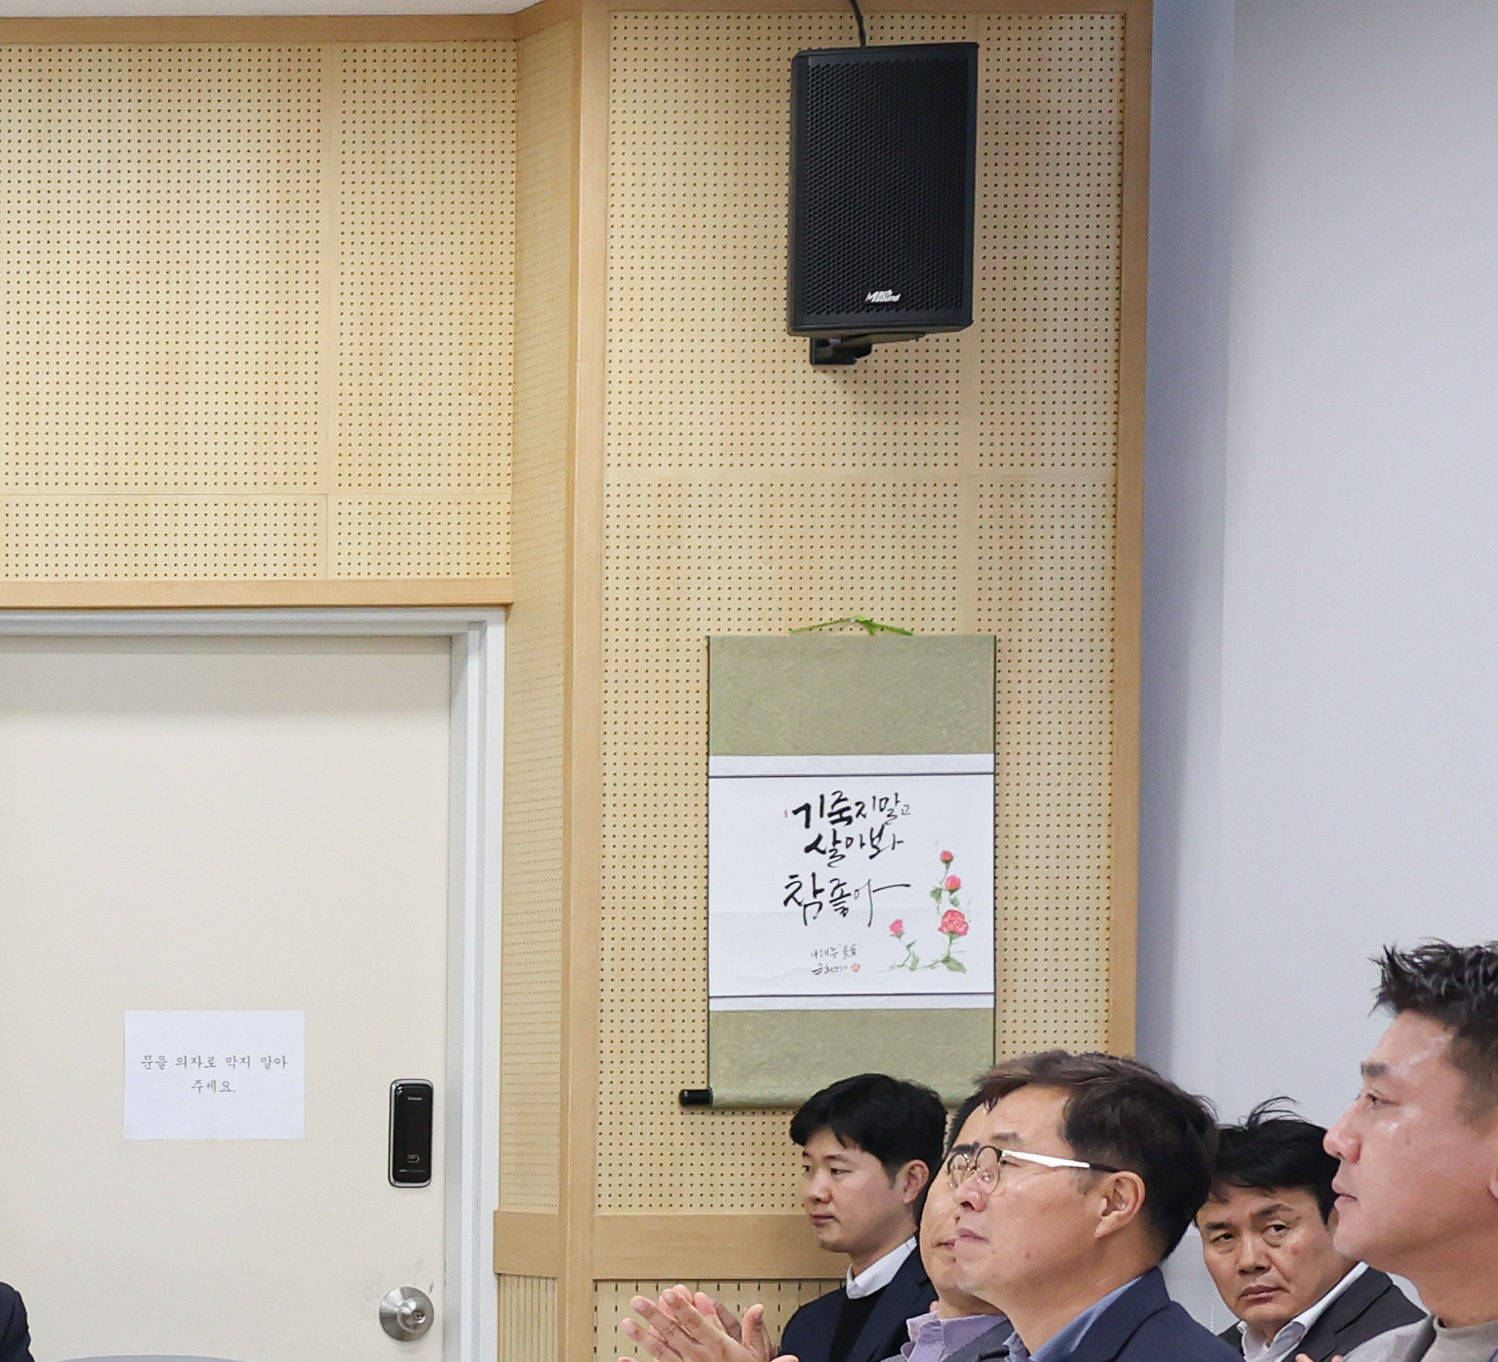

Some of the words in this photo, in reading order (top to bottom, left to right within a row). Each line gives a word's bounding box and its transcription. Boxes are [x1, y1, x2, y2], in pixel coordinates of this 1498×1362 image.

[141, 1055, 167, 1070] 문을
[175, 1055, 217, 1069] 의자로
[225, 1055, 251, 1069] 막지
[259, 1055, 287, 1069] 말아
[191, 1079, 237, 1094] 주세요.
